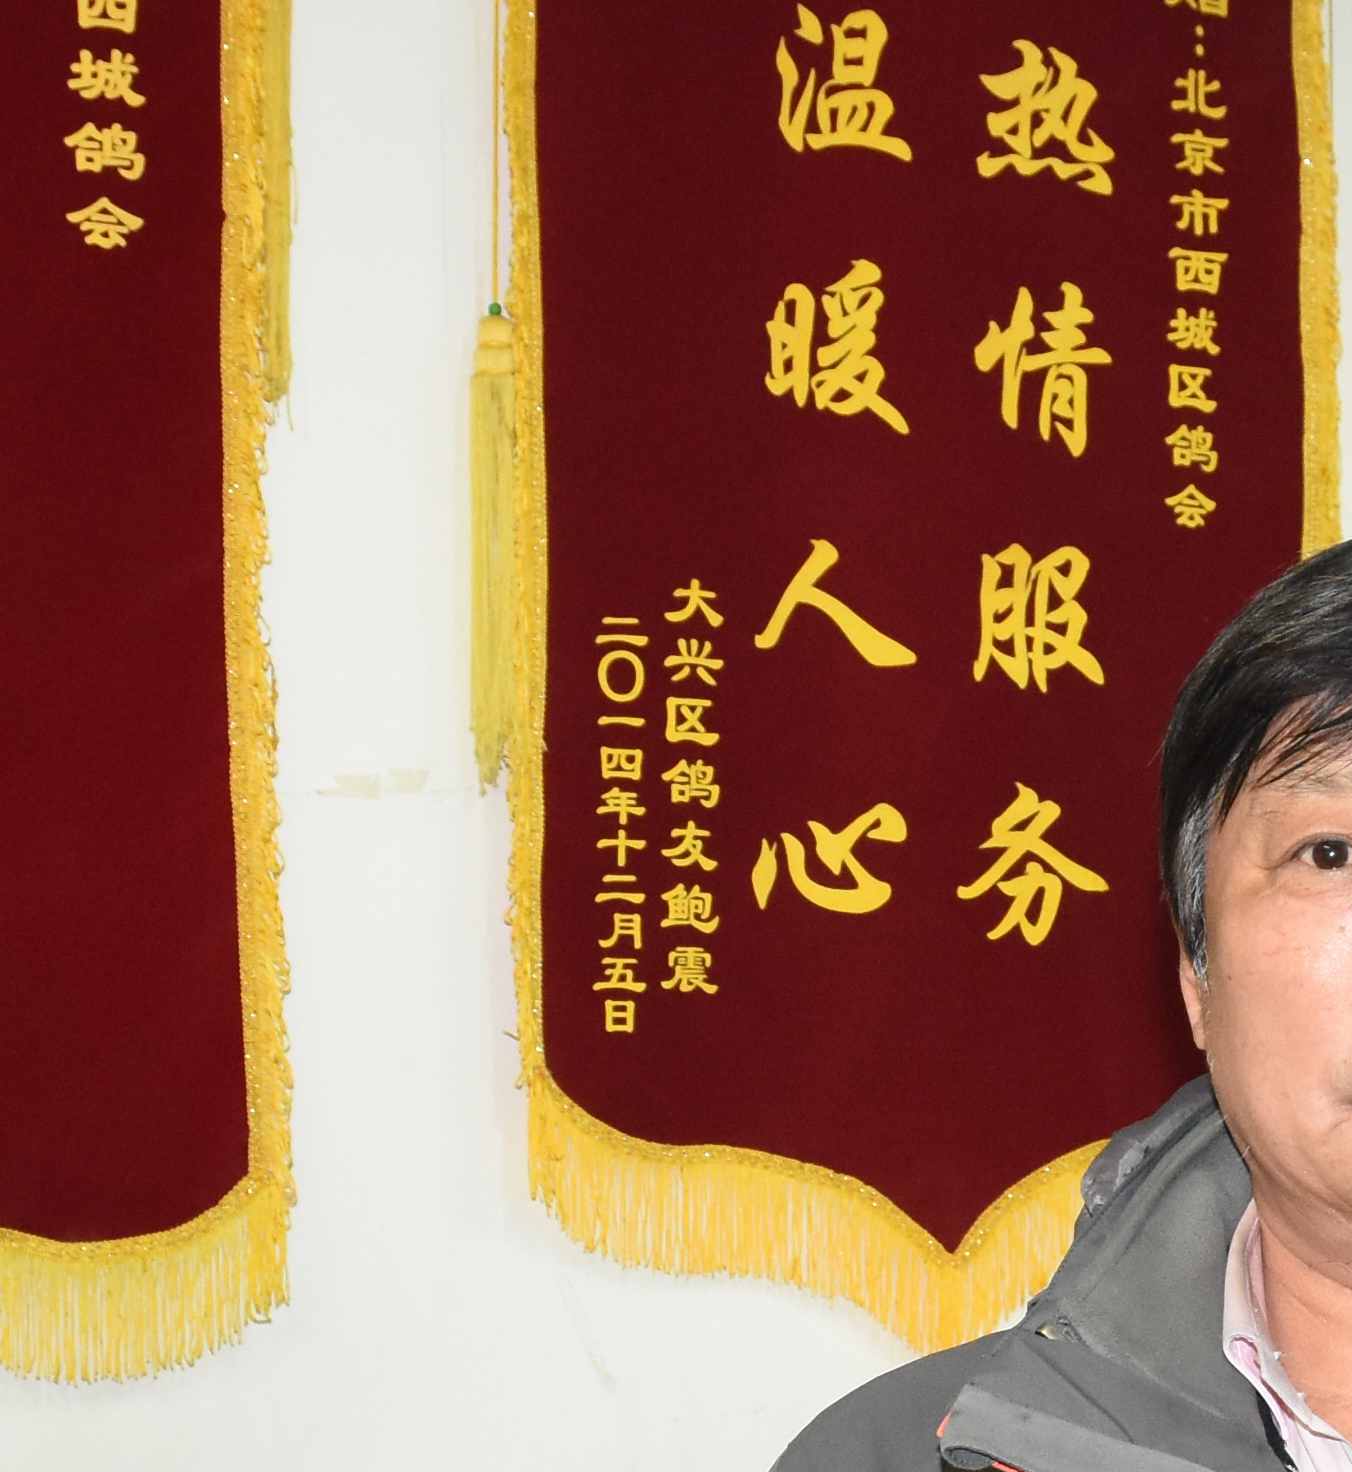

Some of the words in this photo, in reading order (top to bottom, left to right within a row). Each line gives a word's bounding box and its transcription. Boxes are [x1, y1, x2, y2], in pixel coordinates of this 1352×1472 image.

[661, 578, 725, 995] 大兴区鸽友鲍震
[752, 7, 919, 917] 温暖人心
[957, 39, 1117, 947] 热情服务
